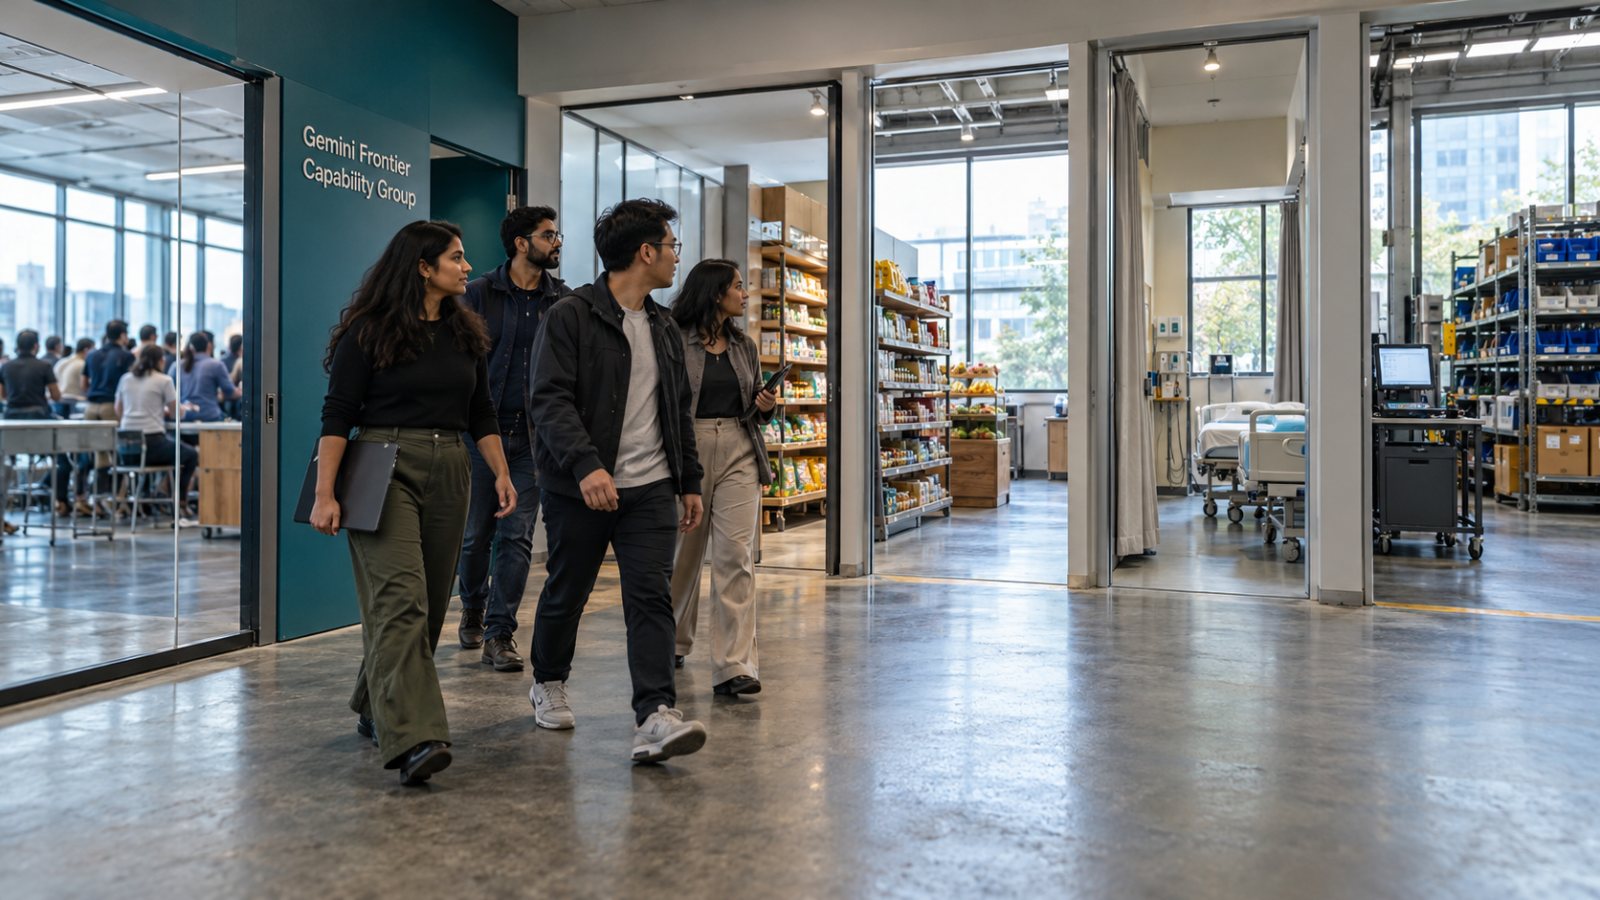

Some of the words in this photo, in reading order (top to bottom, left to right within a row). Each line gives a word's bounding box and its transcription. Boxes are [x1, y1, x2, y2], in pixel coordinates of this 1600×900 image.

[303, 125, 355, 160] Gemini
[359, 143, 411, 177] Frontier
[303, 158, 374, 199] Capability
[377, 179, 417, 210] Group
